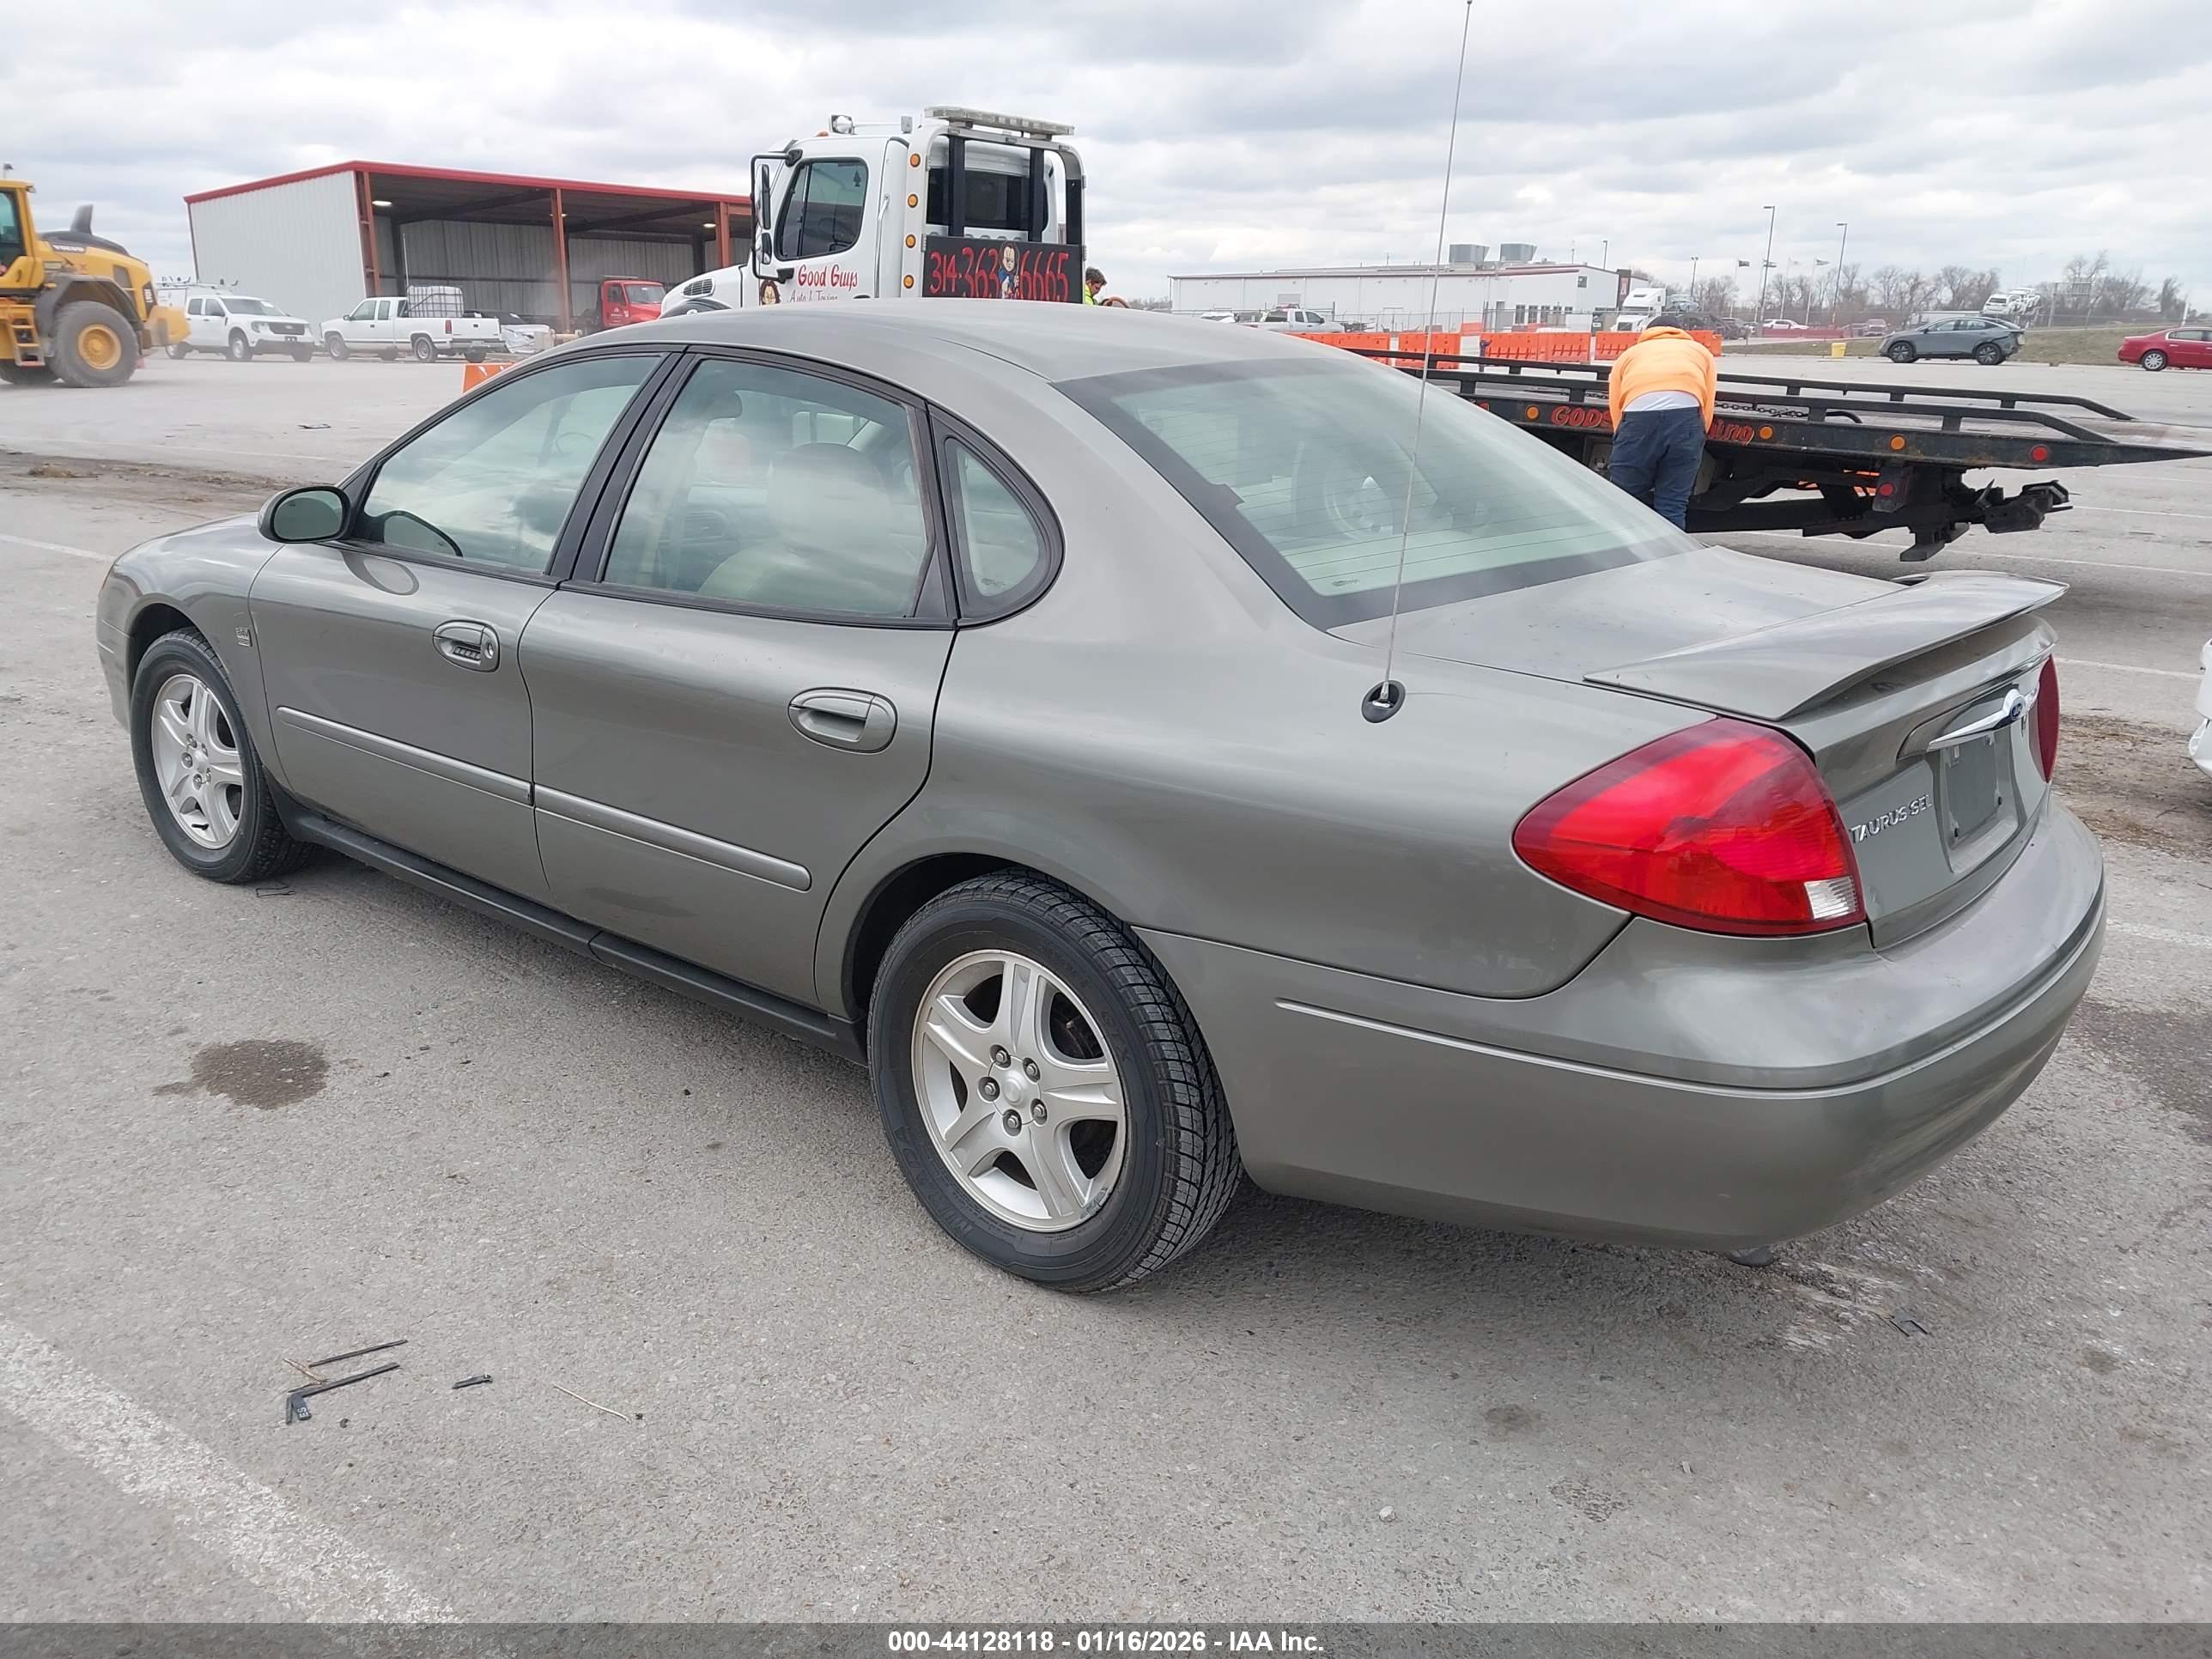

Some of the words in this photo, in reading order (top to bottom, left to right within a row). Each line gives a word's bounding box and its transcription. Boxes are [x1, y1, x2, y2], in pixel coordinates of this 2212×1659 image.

[798, 264, 827, 287] Good
[830, 264, 858, 292] Guys
[1849, 805, 1908, 843] TAURUS
[1909, 793, 1932, 816] SEL
